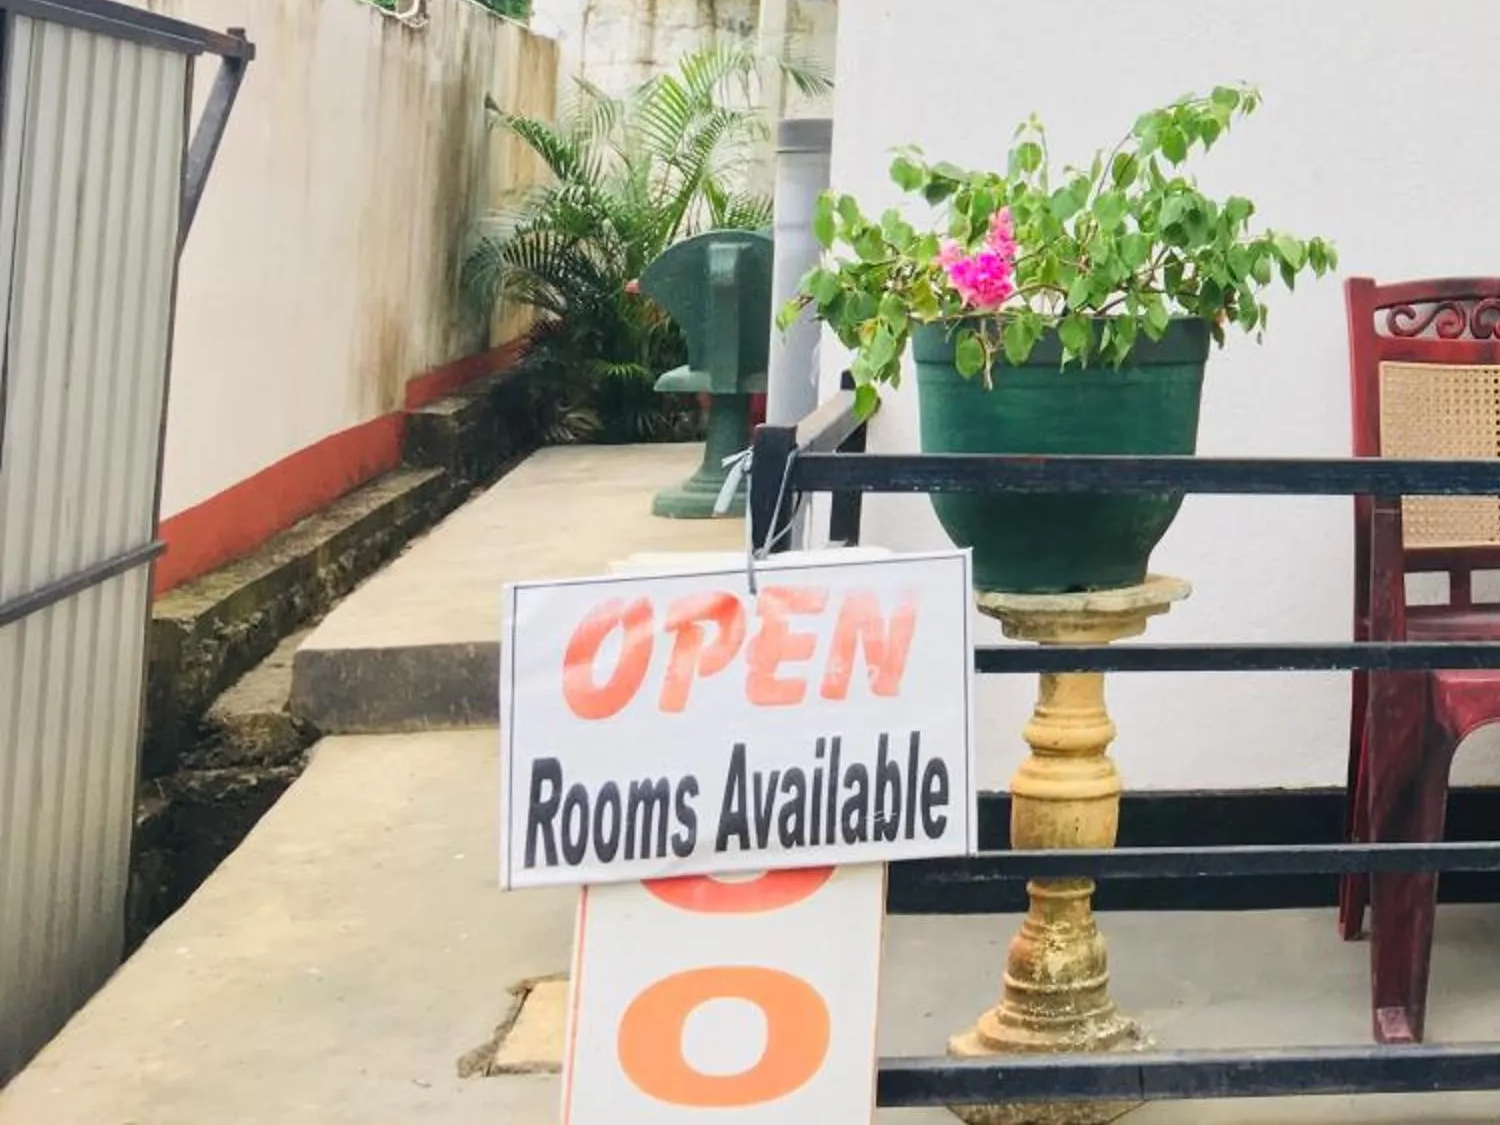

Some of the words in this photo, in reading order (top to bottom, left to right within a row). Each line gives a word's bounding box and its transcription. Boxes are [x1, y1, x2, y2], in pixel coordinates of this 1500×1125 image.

[561, 585, 920, 721] OPEN
[524, 756, 699, 869] Rooms
[715, 730, 950, 853] Available
